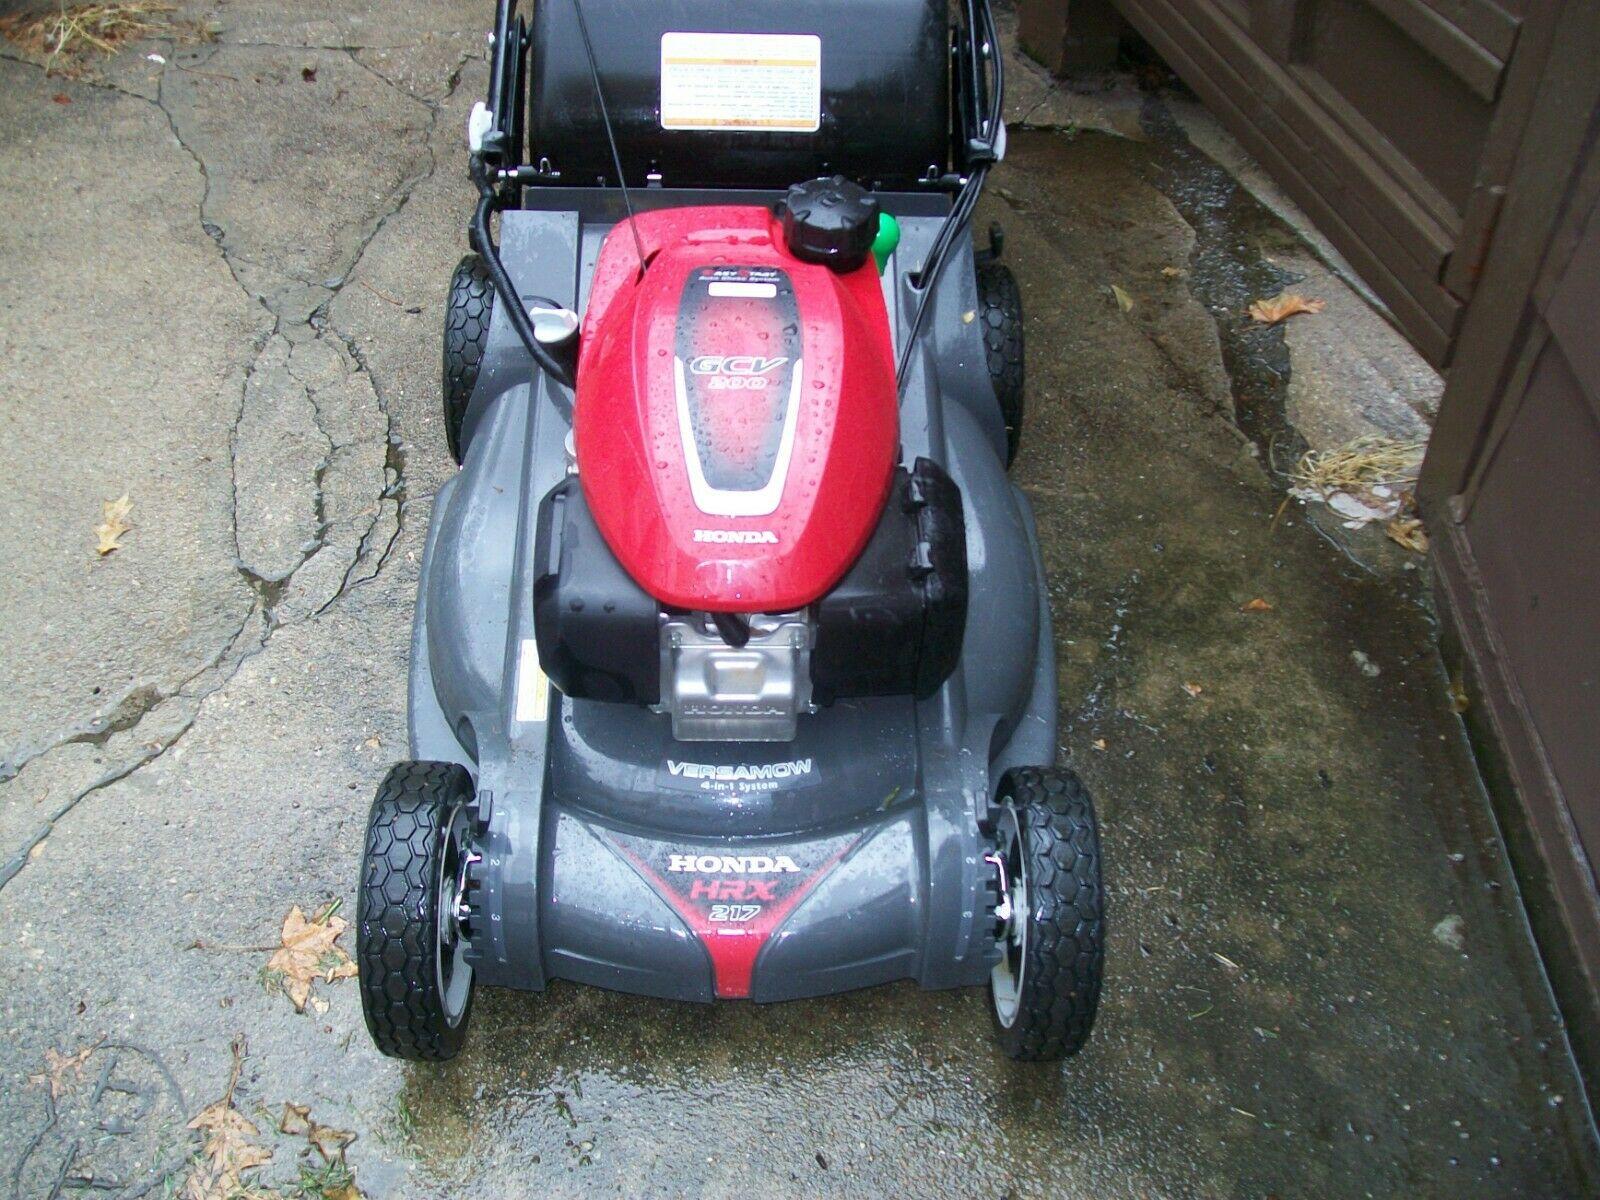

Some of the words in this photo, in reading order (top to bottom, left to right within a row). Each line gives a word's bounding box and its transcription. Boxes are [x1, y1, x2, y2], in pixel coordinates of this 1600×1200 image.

[690, 356, 789, 375] GCV
[708, 376, 769, 390] 200
[693, 529, 779, 544] HONDA
[684, 704, 786, 716] HONDA
[666, 758, 812, 781] VERSAMOW
[700, 780, 735, 791] 4-in-1
[739, 780, 779, 793] System
[490, 858, 500, 867] 2
[668, 854, 801, 873] HONDA
[689, 879, 779, 901] HRX
[491, 913, 500, 921] 3
[708, 904, 762, 922] 217
